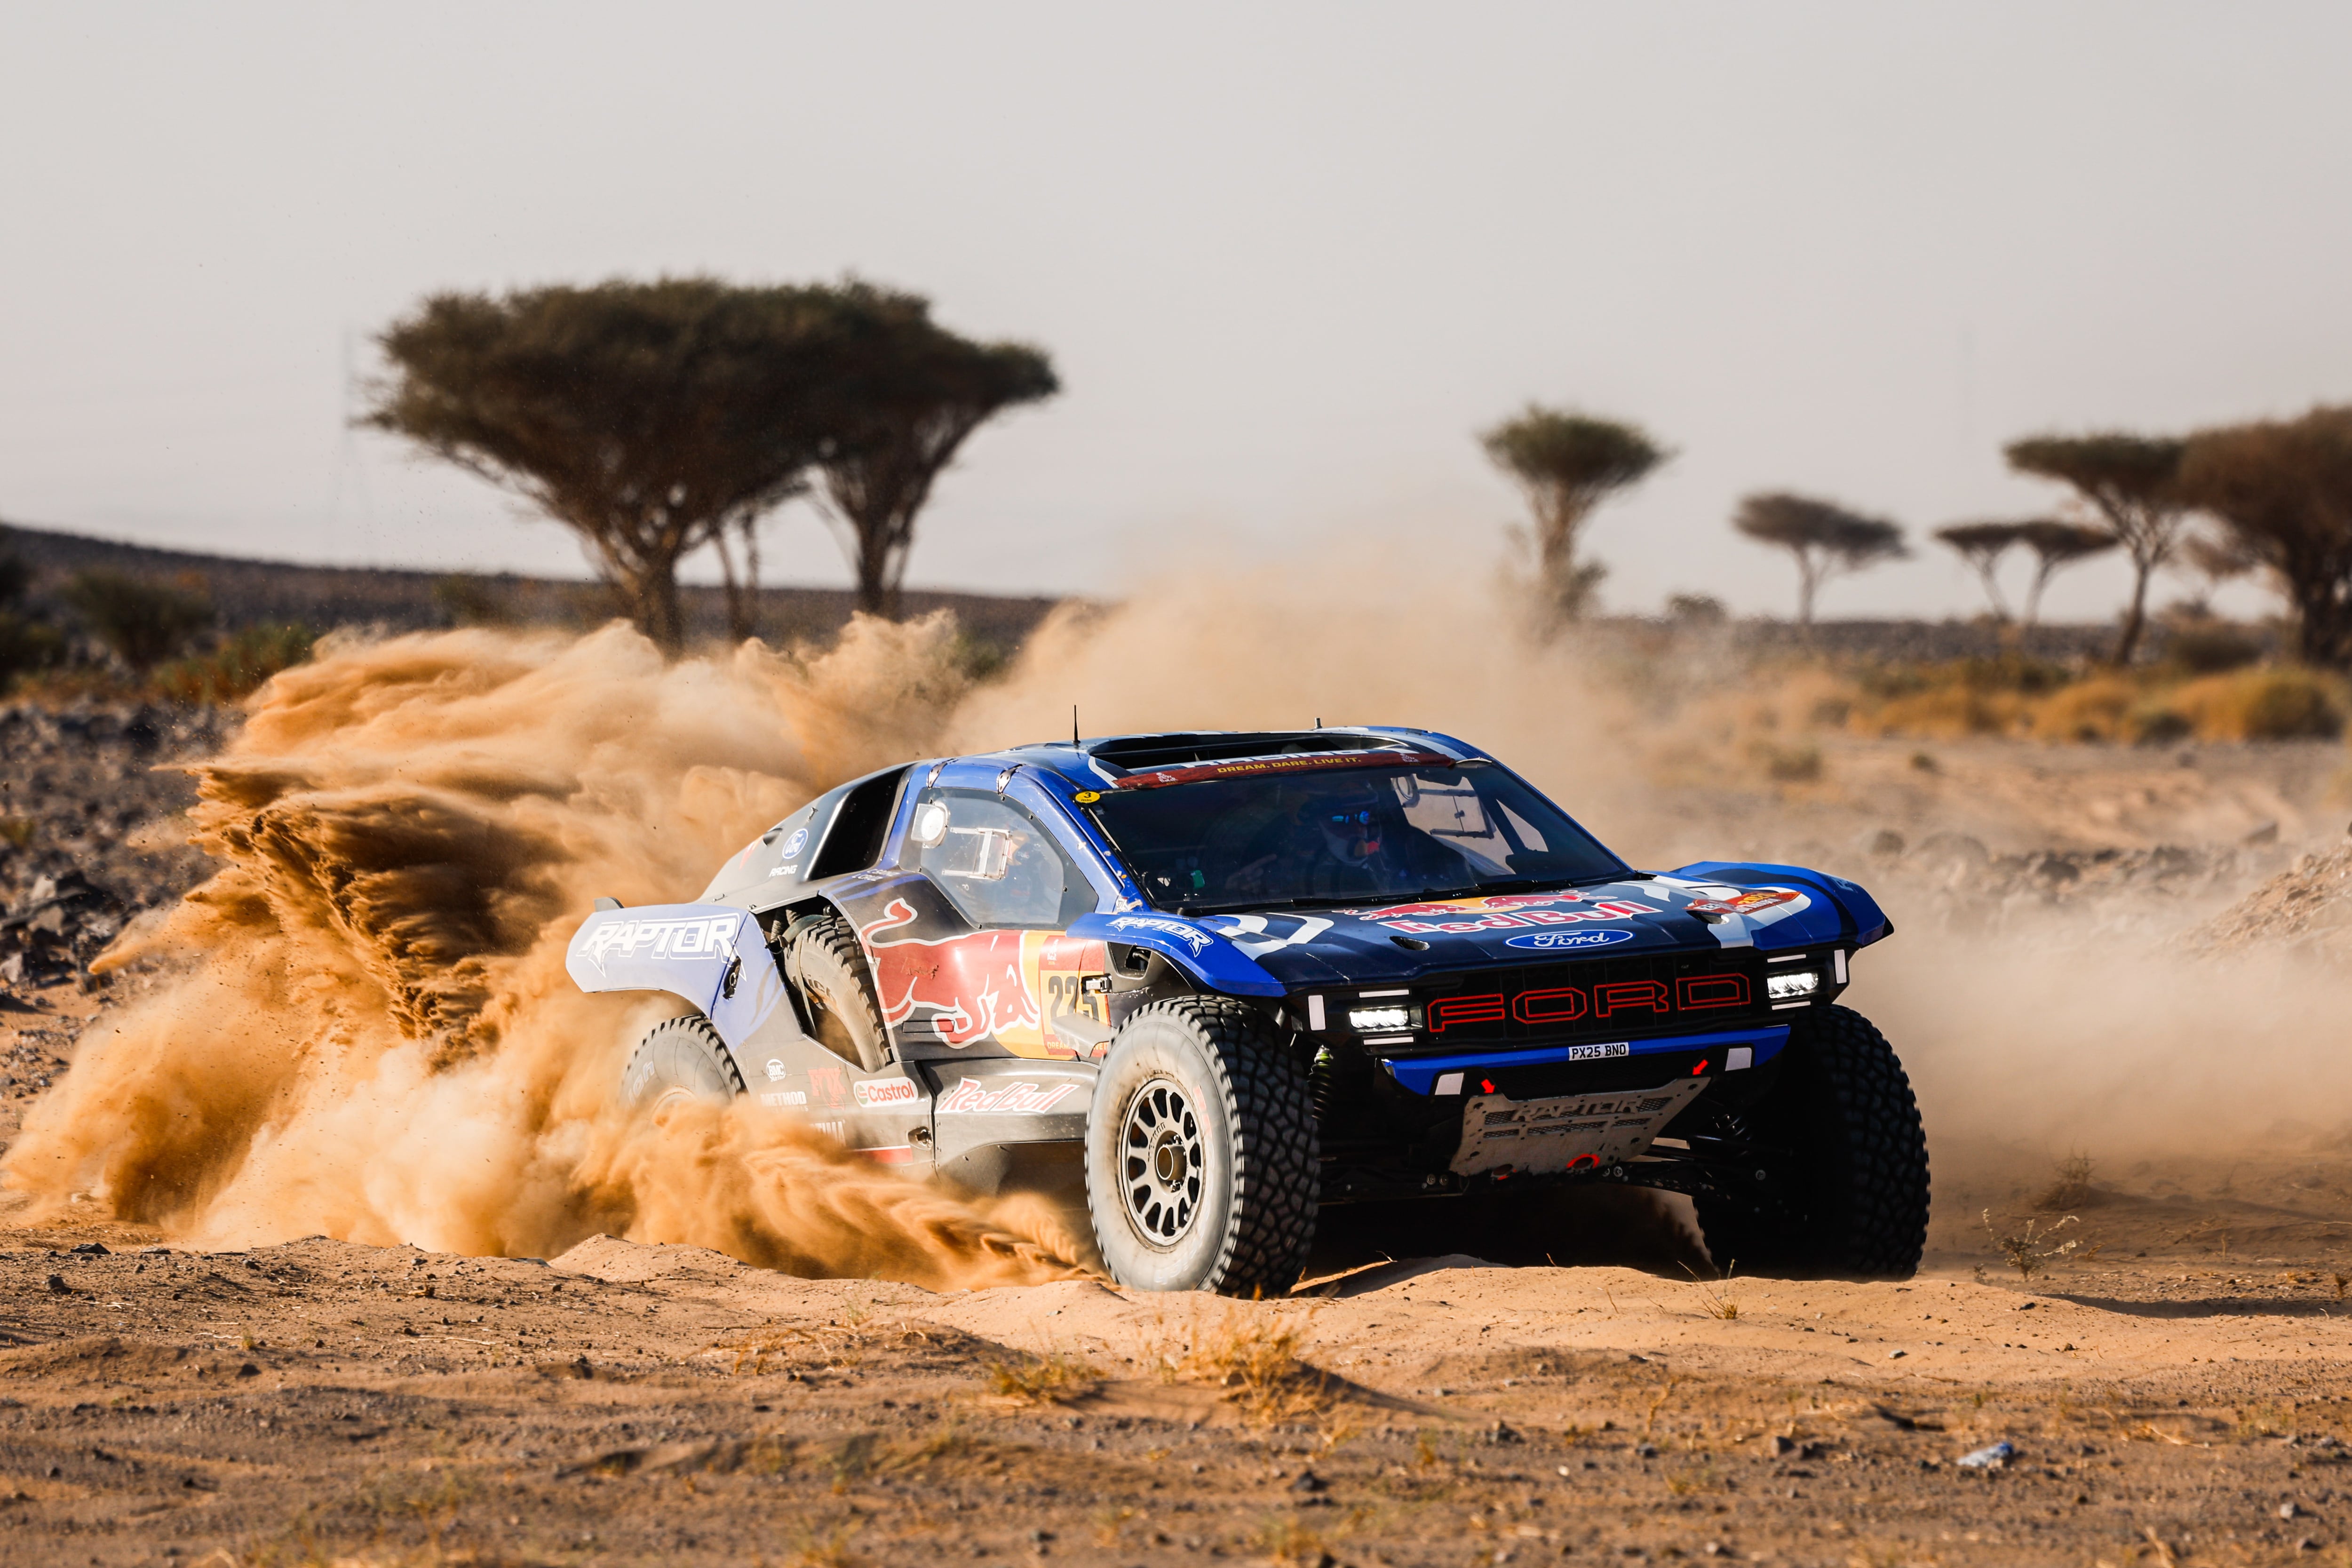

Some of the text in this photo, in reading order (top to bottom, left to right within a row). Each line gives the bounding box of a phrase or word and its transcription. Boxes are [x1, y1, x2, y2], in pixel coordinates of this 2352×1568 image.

[1216, 763, 1270, 773] DREAM.
[769, 865, 798, 877] RACING
[1377, 900, 1664, 934] Red Bull
[576, 913, 747, 981] RAPTOR
[1105, 916, 1214, 958] RAPTOR
[1428, 972, 1751, 1033] FORD
[1572, 1046, 1601, 1059] PX25
[768, 1065, 785, 1076] BMC
[807, 1067, 846, 1101] FOX
[867, 1081, 915, 1103] Castrol
[936, 1077, 1081, 1114] Red Bull
[760, 1091, 807, 1106] METHOD
[1511, 1100, 1640, 1123] RAPTOR
